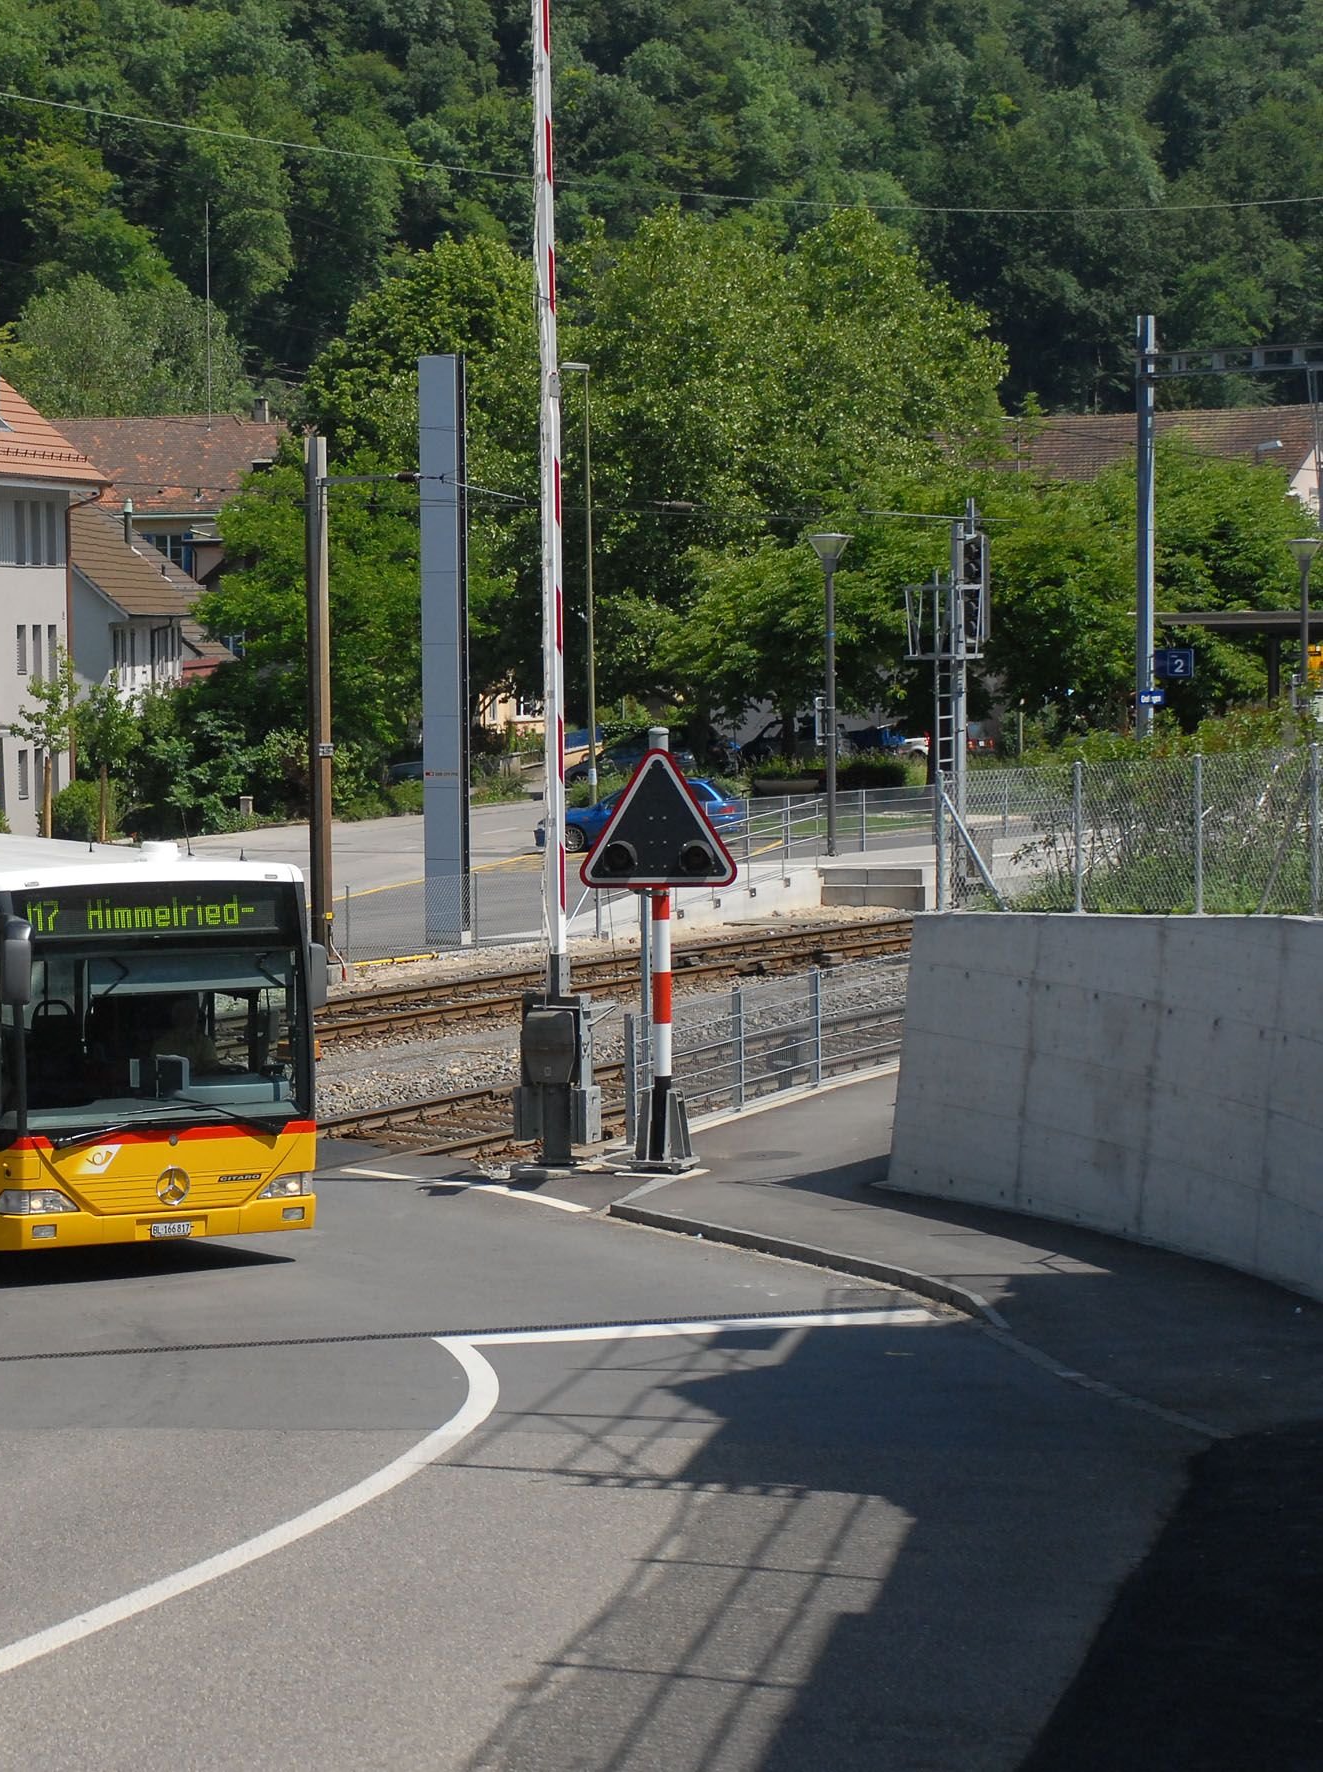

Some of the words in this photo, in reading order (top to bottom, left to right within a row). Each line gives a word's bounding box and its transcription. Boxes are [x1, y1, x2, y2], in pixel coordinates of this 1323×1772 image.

[1174, 659, 1184, 673] 2
[26, 900, 60, 931] 117
[87, 895, 255, 929] Himmelried-
[220, 1174, 260, 1182] CITARO
